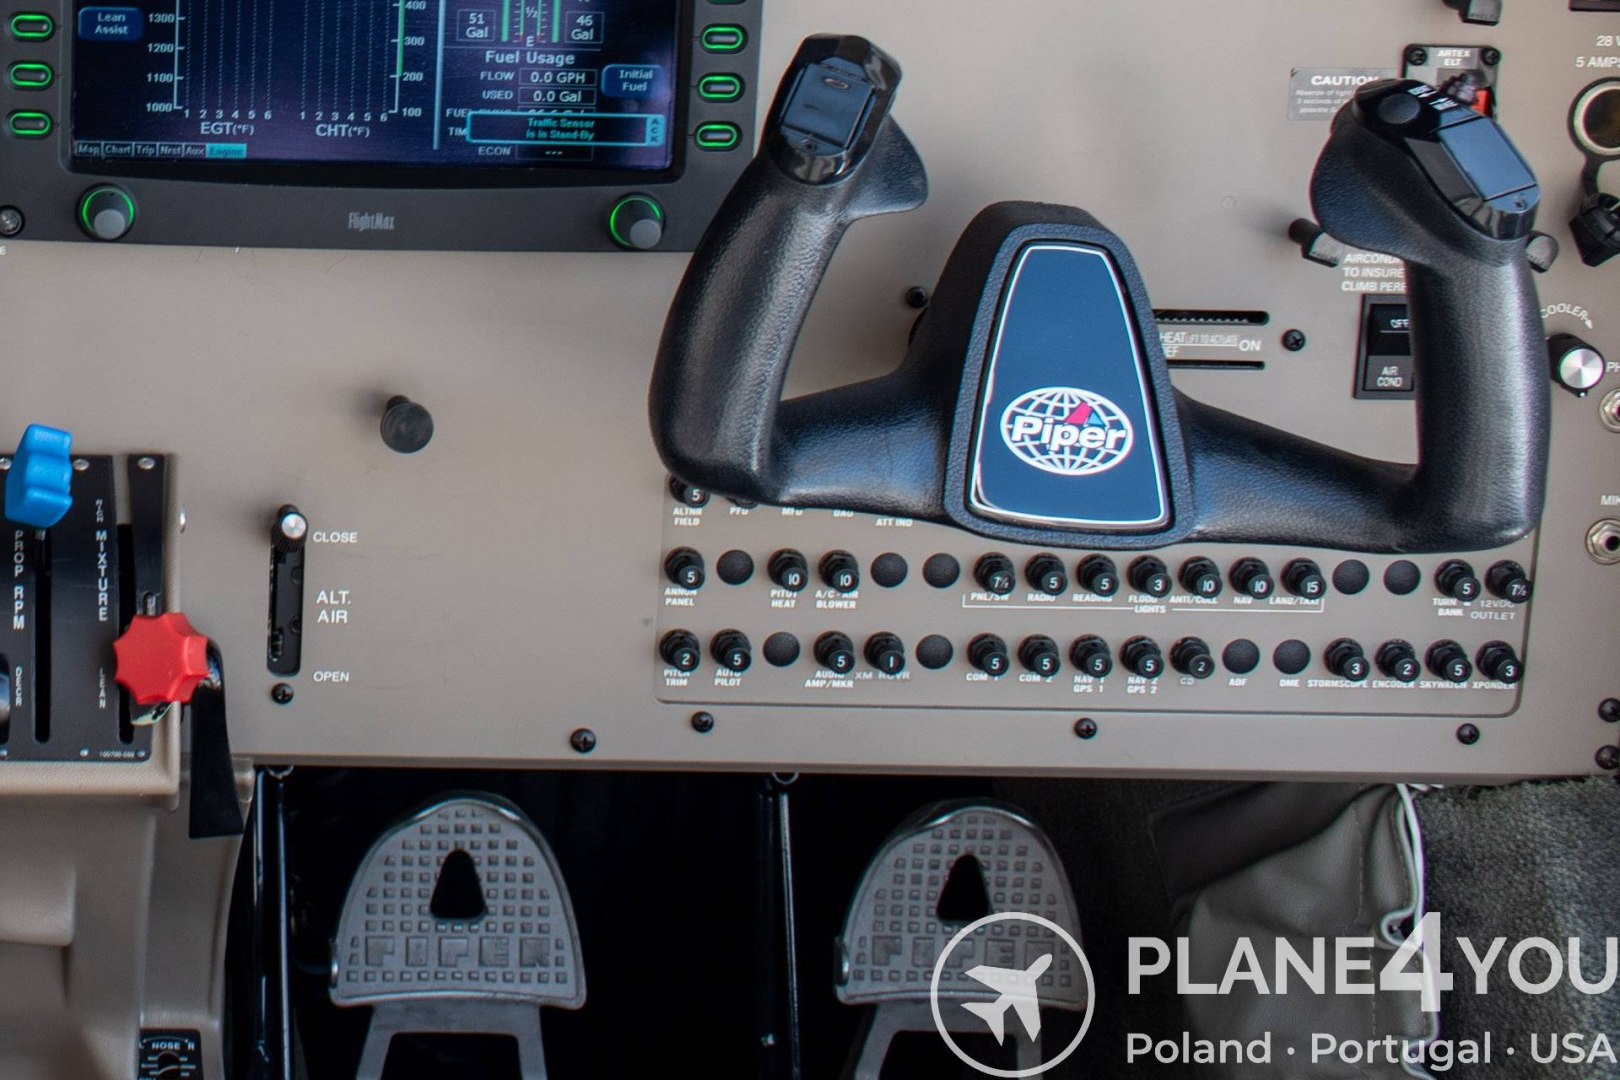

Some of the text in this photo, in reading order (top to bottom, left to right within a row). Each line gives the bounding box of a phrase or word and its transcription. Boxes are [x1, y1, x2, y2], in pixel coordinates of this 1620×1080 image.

[1596, 35, 1613, 46] 28
[485, 51, 576, 67] Fuel Usage
[1438, 50, 1471, 58] ARTEX
[1444, 58, 1461, 66] ELT
[1576, 56, 1585, 67] 5
[480, 72, 515, 81] FLOW
[530, 72, 586, 83] 0.0 GPH
[482, 90, 514, 100] USED
[533, 91, 581, 102] 0.0 Gal
[1239, 340, 1260, 351] ON
[1382, 366, 1398, 375] AIR
[1377, 377, 1402, 387] COND
[1012, 416, 1127, 451] Piper
[313, 532, 358, 543] CLOSE
[13, 530, 24, 630] PROP RPM
[96, 530, 108, 621] MIXTURE
[316, 590, 352, 605] ALT.
[665, 597, 695, 607] PANEL
[816, 599, 856, 609] BLOWER
[1134, 605, 1166, 614] LIGHTS
[317, 609, 348, 624] AIR
[1470, 611, 1516, 621] OUTLET
[314, 671, 350, 682] OPEN
[714, 677, 741, 686] PILOT
[665, 678, 687, 686] TRIM
[805, 678, 854, 689] AMP/MKR
[1228, 678, 1247, 688] ADF
[1280, 678, 1299, 688] DME
[1307, 679, 1368, 689] STORMSCOPE
